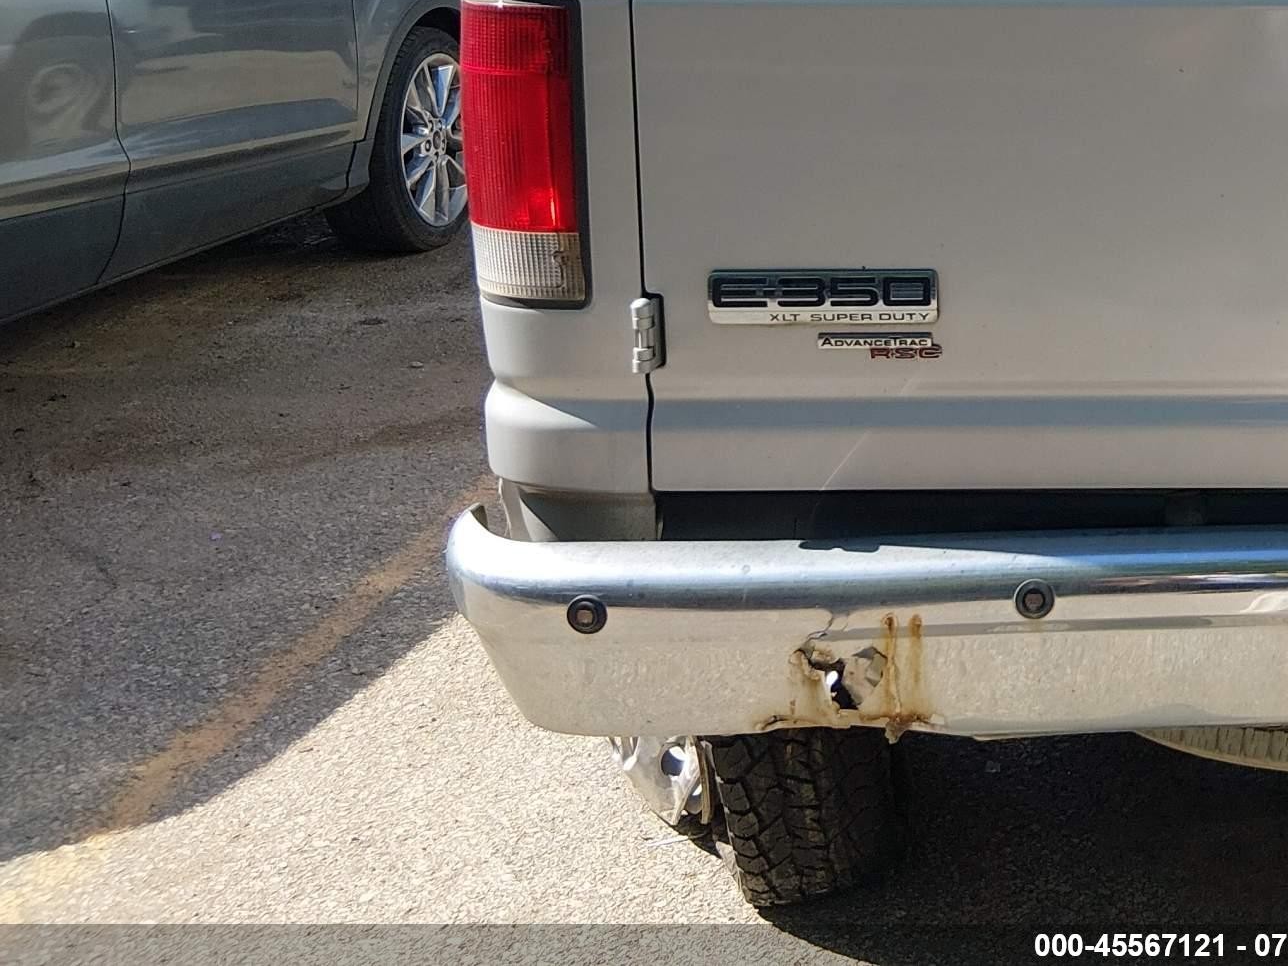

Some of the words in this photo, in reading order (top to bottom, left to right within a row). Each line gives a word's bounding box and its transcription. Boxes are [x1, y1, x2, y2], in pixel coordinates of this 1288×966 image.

[769, 313, 800, 322] XLT
[810, 313, 873, 322] SUPER
[878, 312, 930, 321] DUTY
[870, 347, 943, 359] RSC
